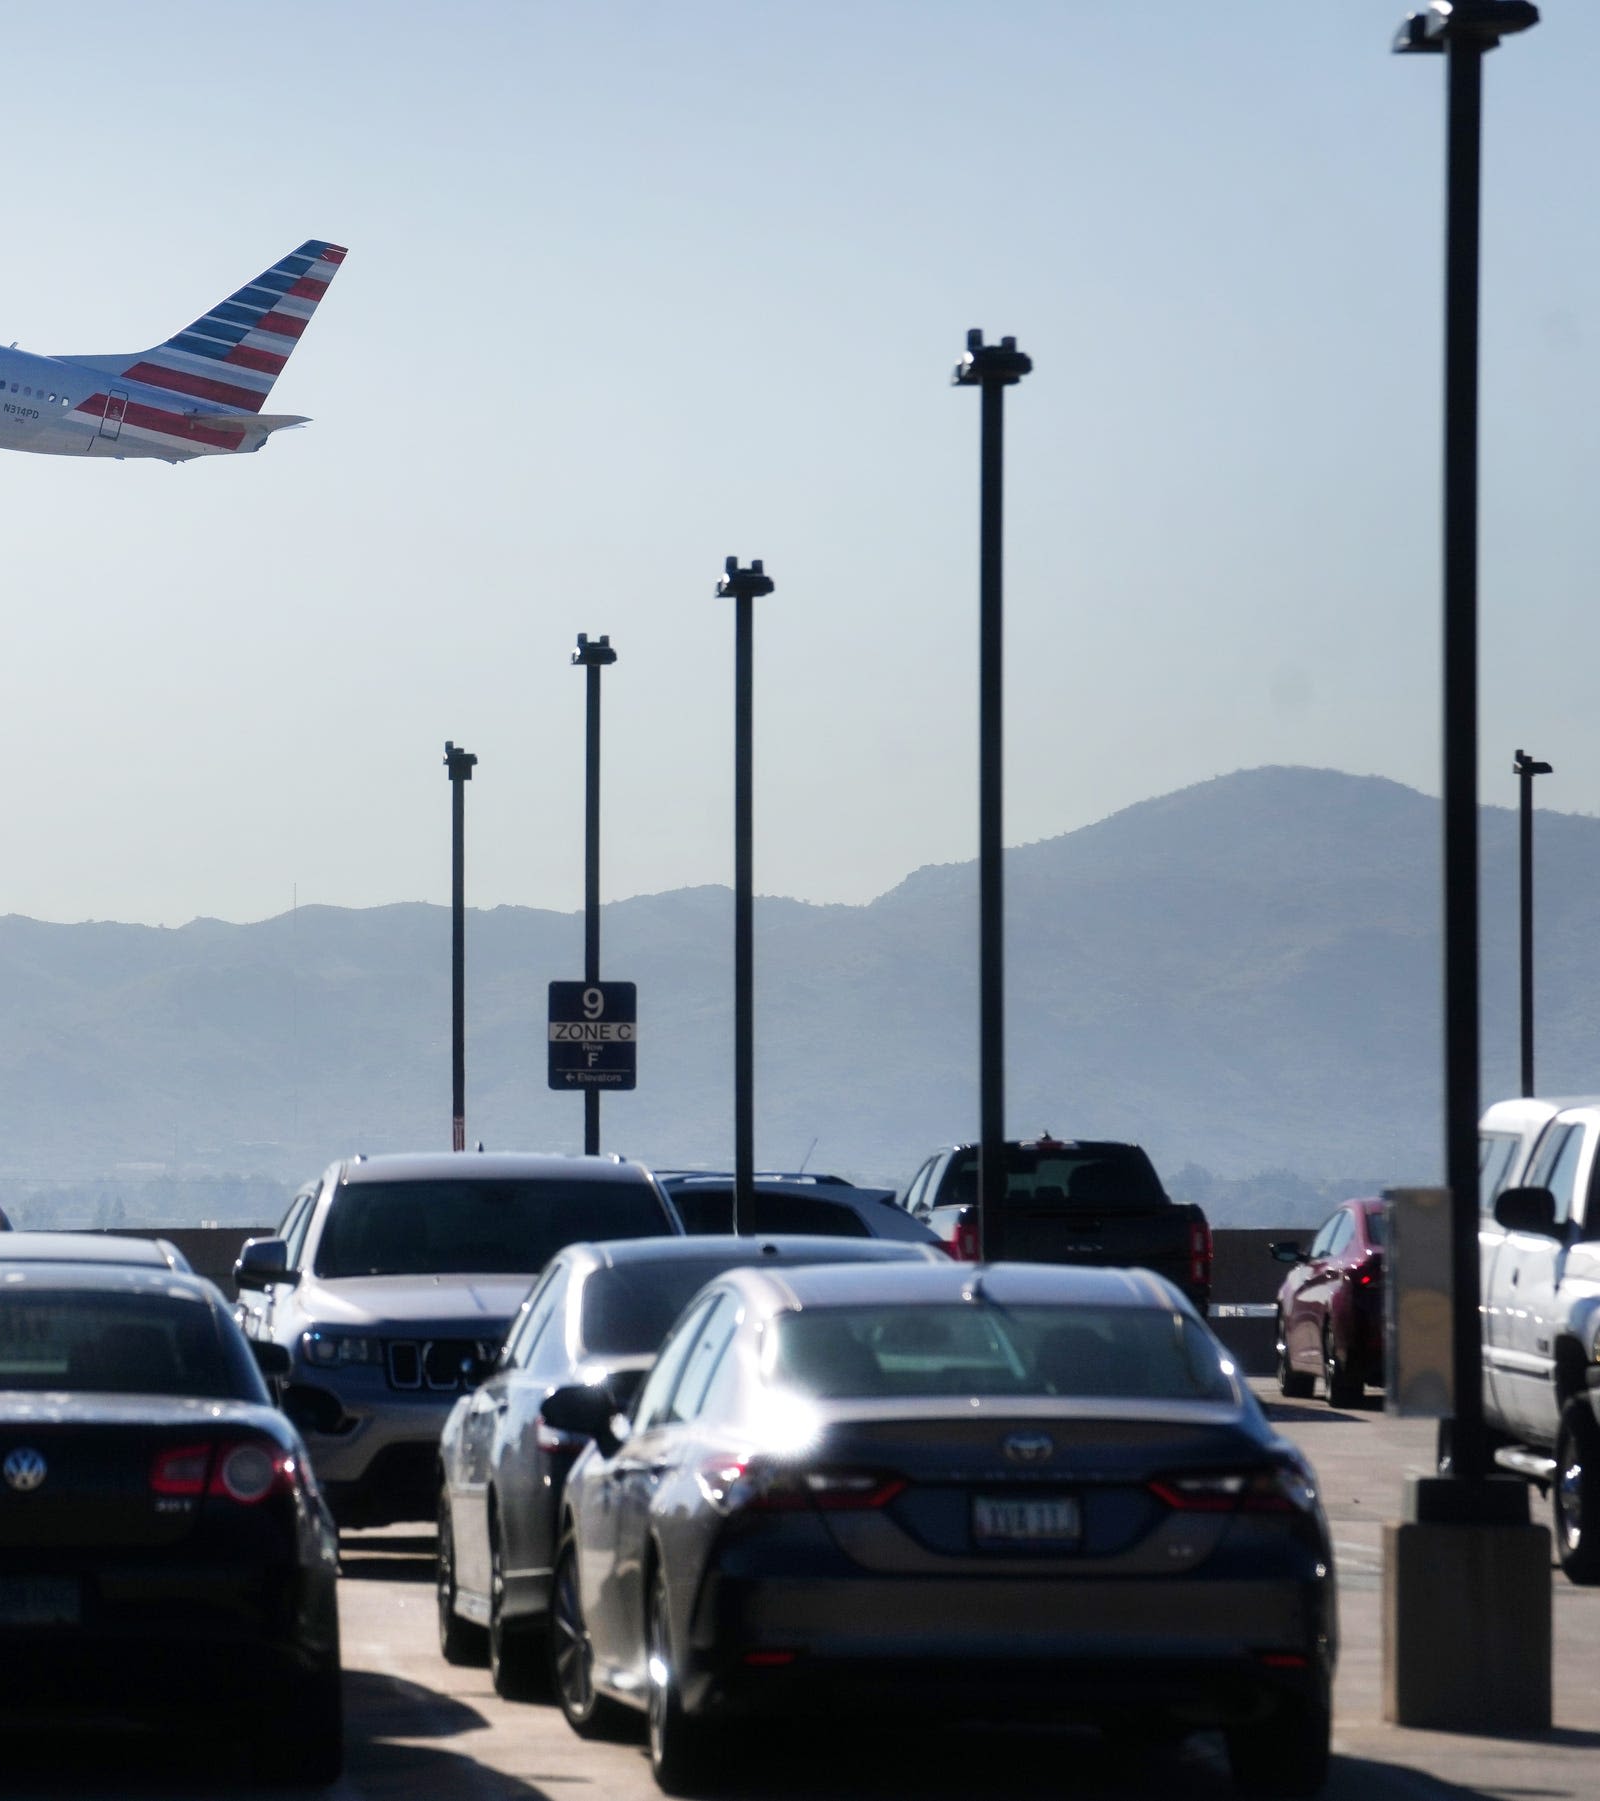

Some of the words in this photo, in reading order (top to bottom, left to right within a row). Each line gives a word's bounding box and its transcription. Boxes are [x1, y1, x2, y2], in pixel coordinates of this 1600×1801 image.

[4, 403, 39, 419] N314PD
[583, 988, 604, 1019] 9
[555, 1024, 610, 1040] ZONE
[618, 1024, 631, 1040] C
[582, 1043, 603, 1051] Row
[588, 1053, 598, 1067] F
[578, 1073, 622, 1081] Elevators
